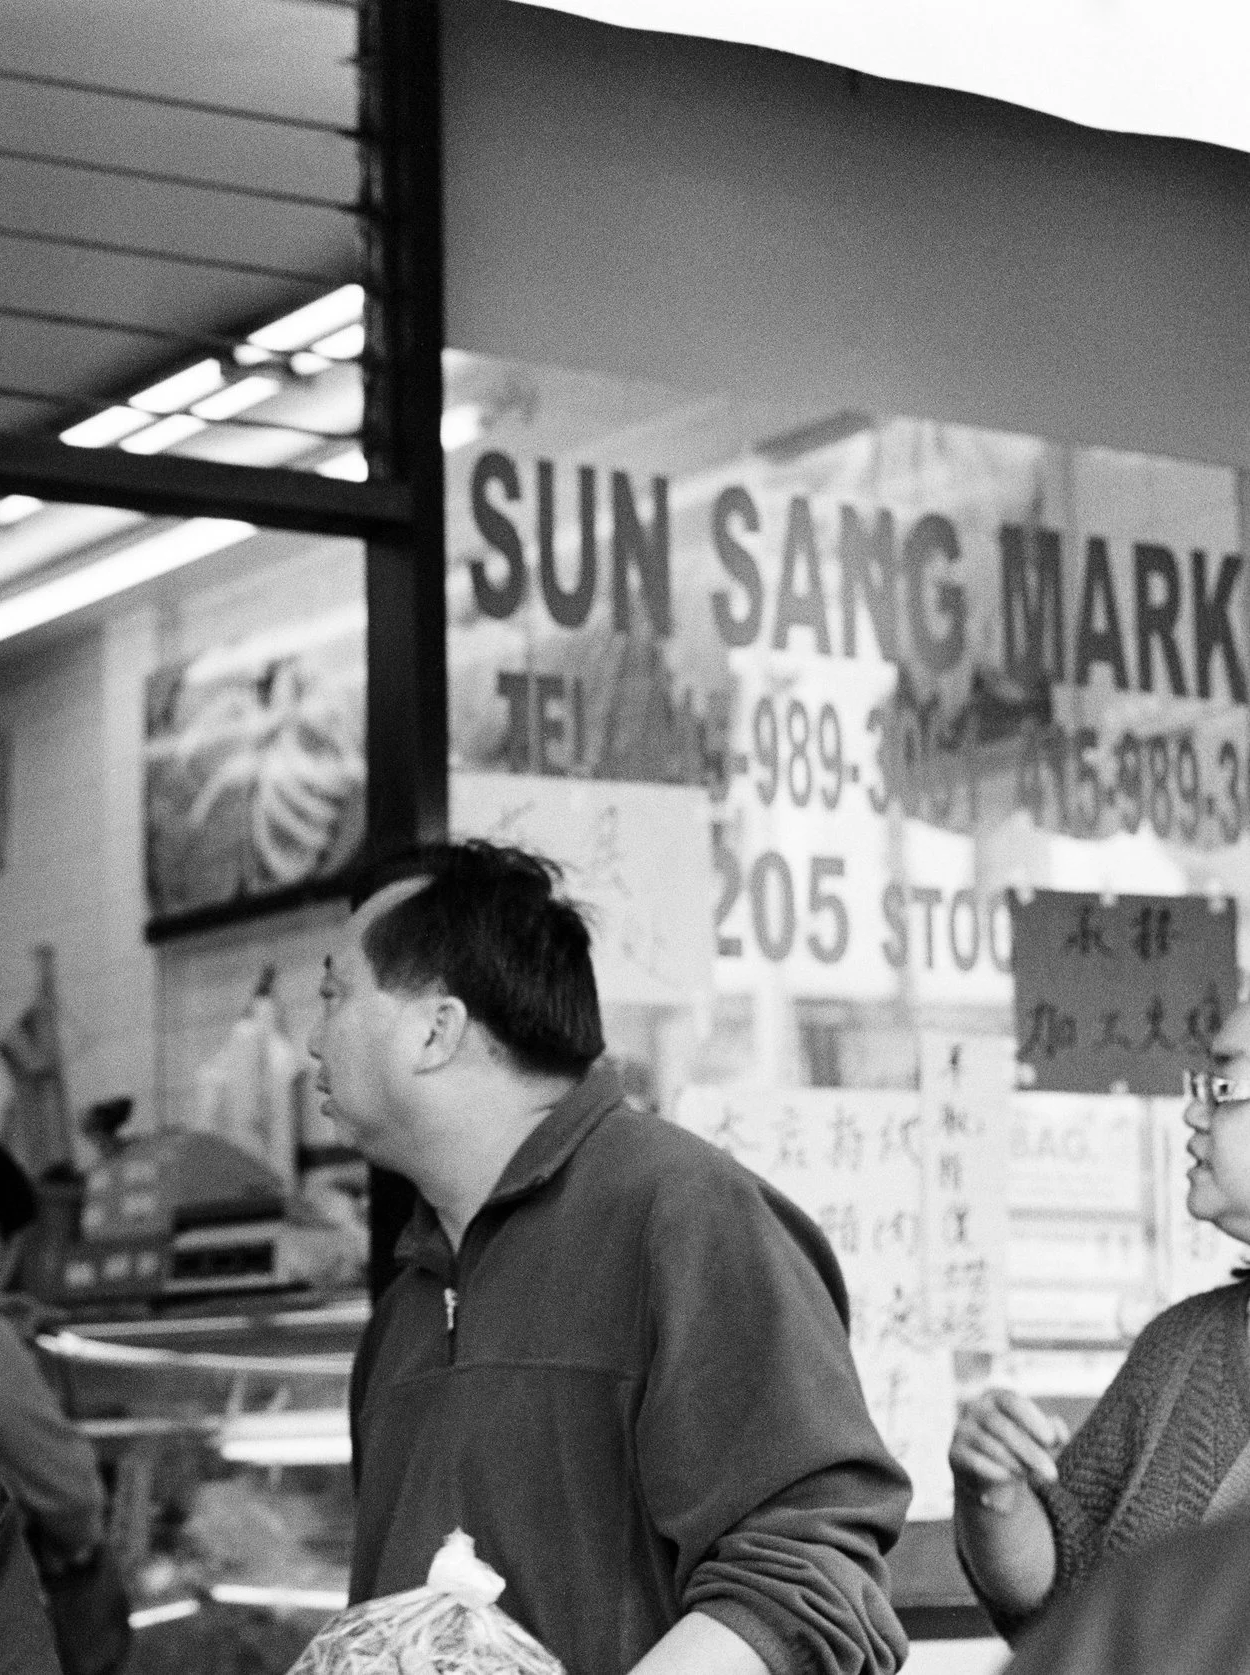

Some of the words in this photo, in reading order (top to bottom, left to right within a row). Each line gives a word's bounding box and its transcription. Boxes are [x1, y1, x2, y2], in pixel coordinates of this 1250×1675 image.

[470, 449, 675, 640] SUN
[711, 484, 968, 673] SANG
[999, 522, 1250, 707] MARK
